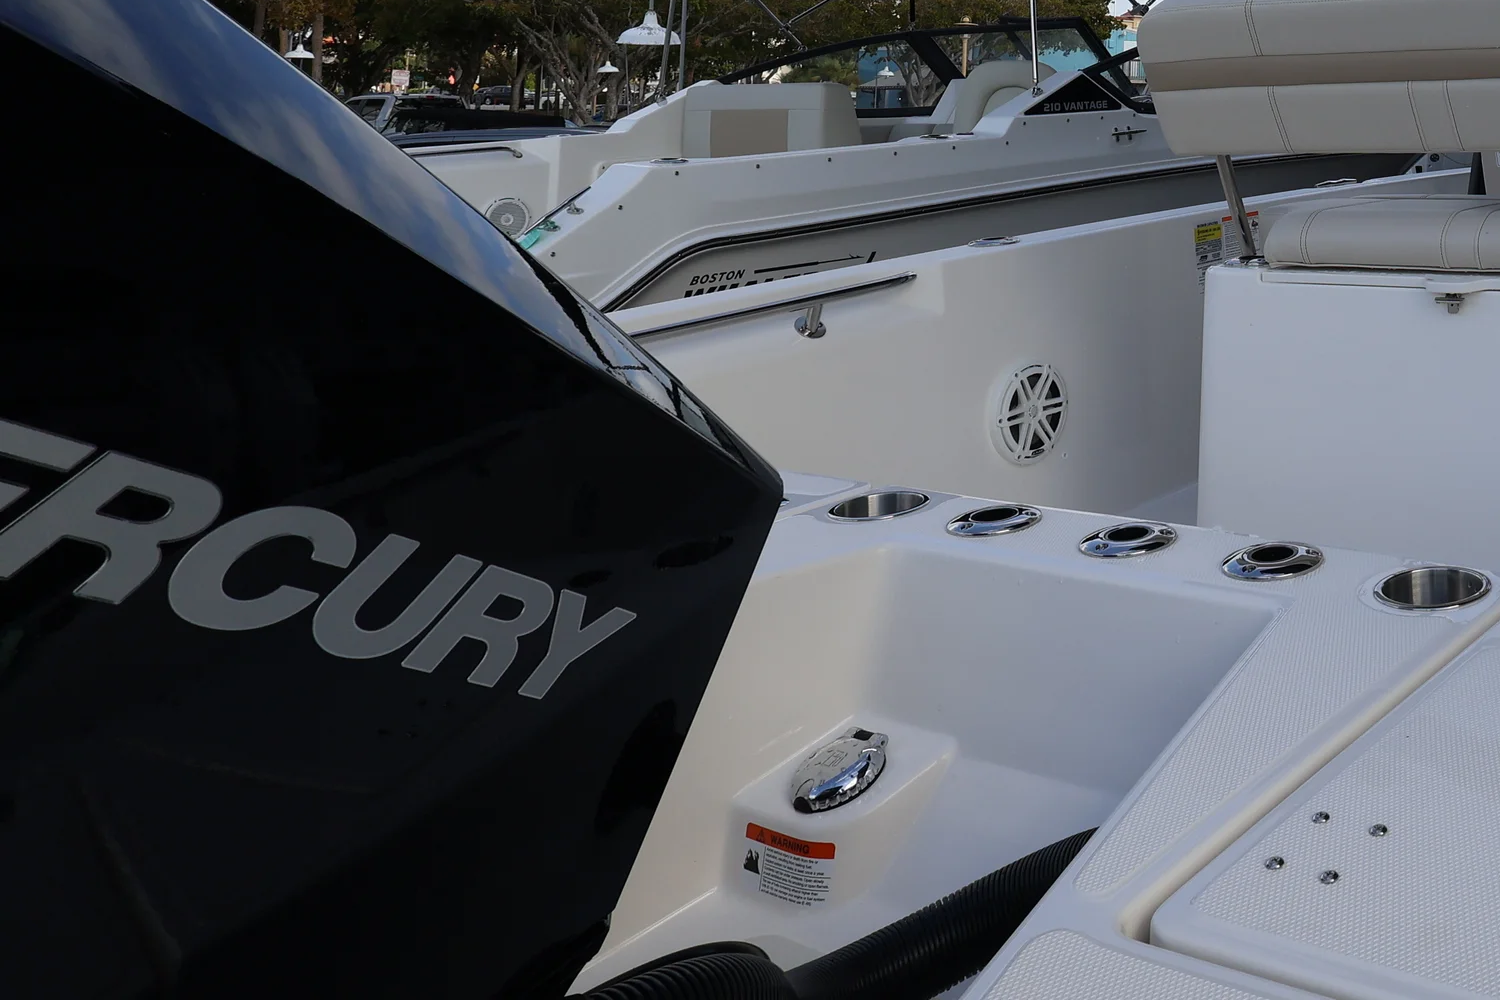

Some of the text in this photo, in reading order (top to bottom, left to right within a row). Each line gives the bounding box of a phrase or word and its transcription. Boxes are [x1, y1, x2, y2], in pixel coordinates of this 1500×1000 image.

[1043, 100, 1108, 112] 210 VANTAGE
[689, 269, 745, 286] BOSTON
[770, 835, 809, 854] WARNING
